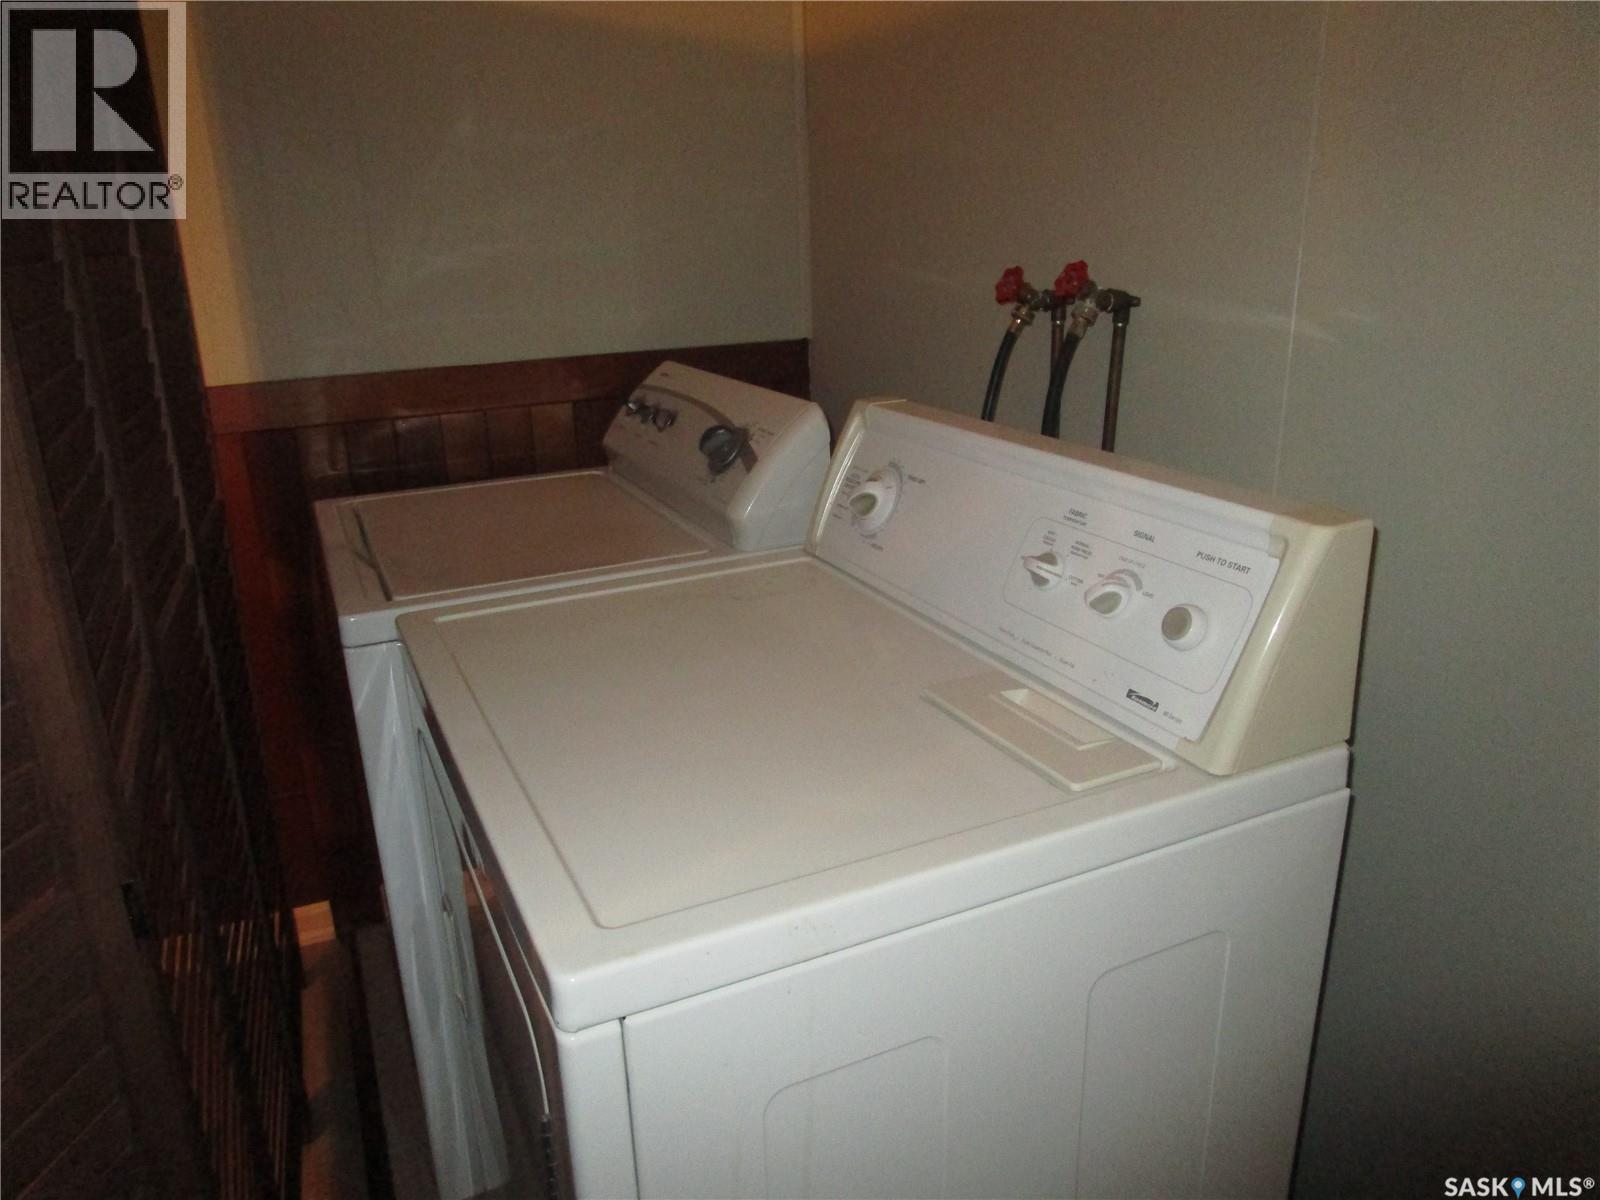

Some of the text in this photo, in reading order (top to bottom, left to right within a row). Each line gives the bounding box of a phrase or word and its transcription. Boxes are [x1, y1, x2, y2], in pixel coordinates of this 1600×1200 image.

[1133, 529, 1156, 543] SIGNAL
[1196, 550, 1252, 575] PUSH TO START
